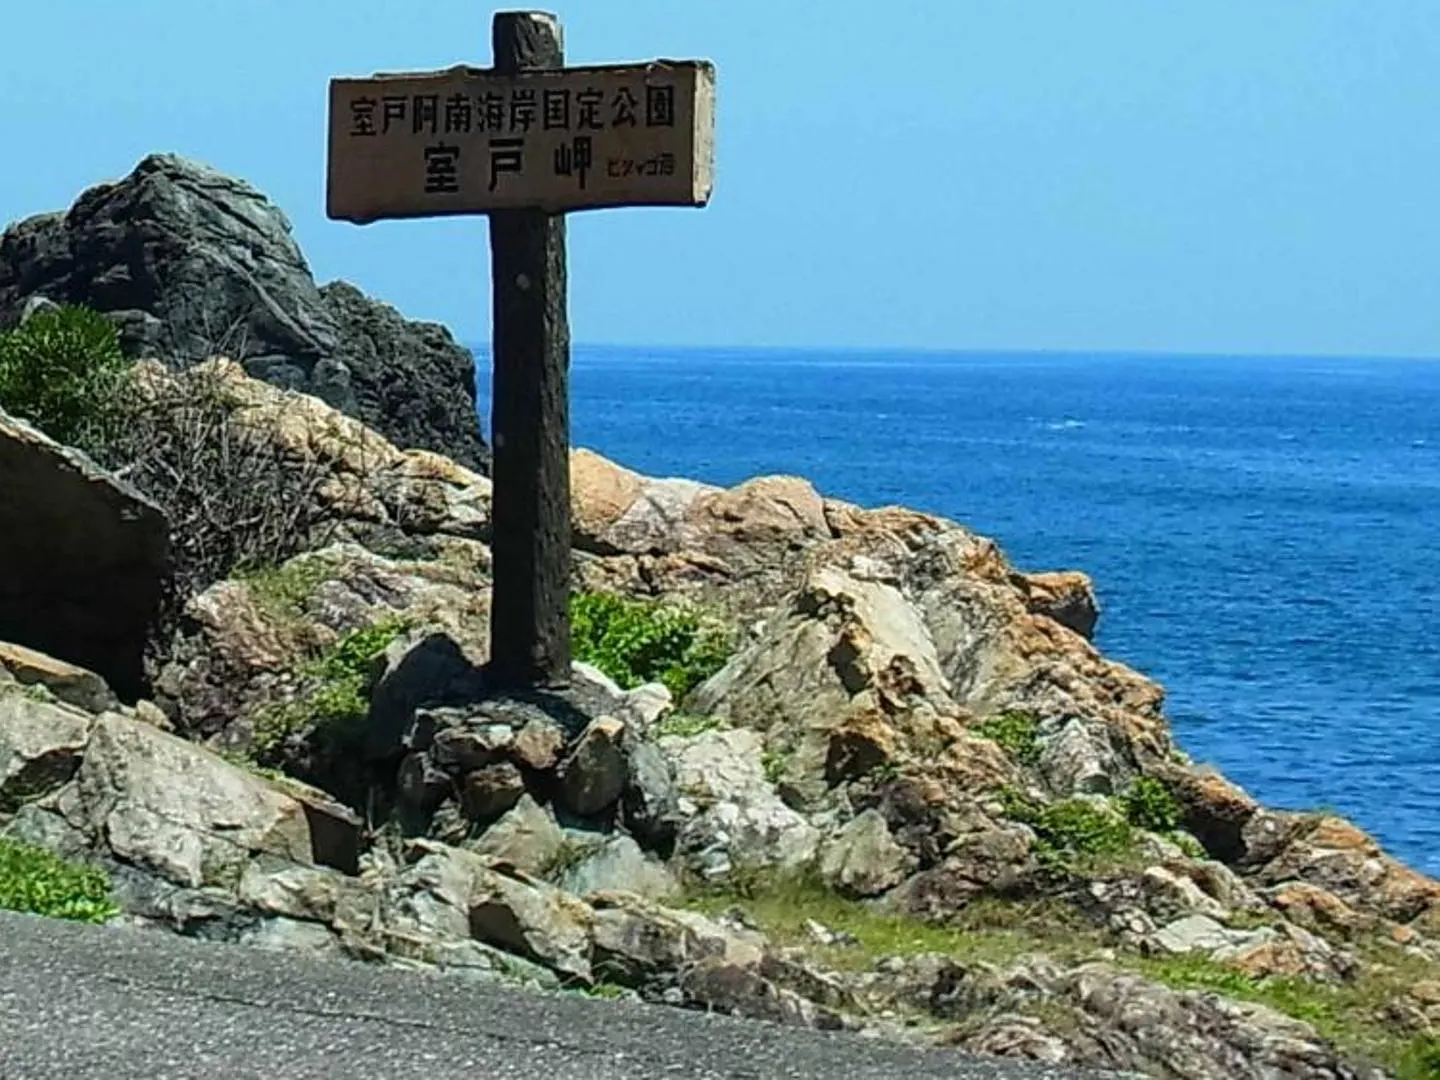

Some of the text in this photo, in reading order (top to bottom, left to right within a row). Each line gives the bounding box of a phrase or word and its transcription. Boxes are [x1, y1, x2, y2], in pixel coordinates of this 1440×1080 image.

[350, 85, 675, 137] 室戸阿南海岸国定公園
[423, 136, 592, 193] 室戸岬
